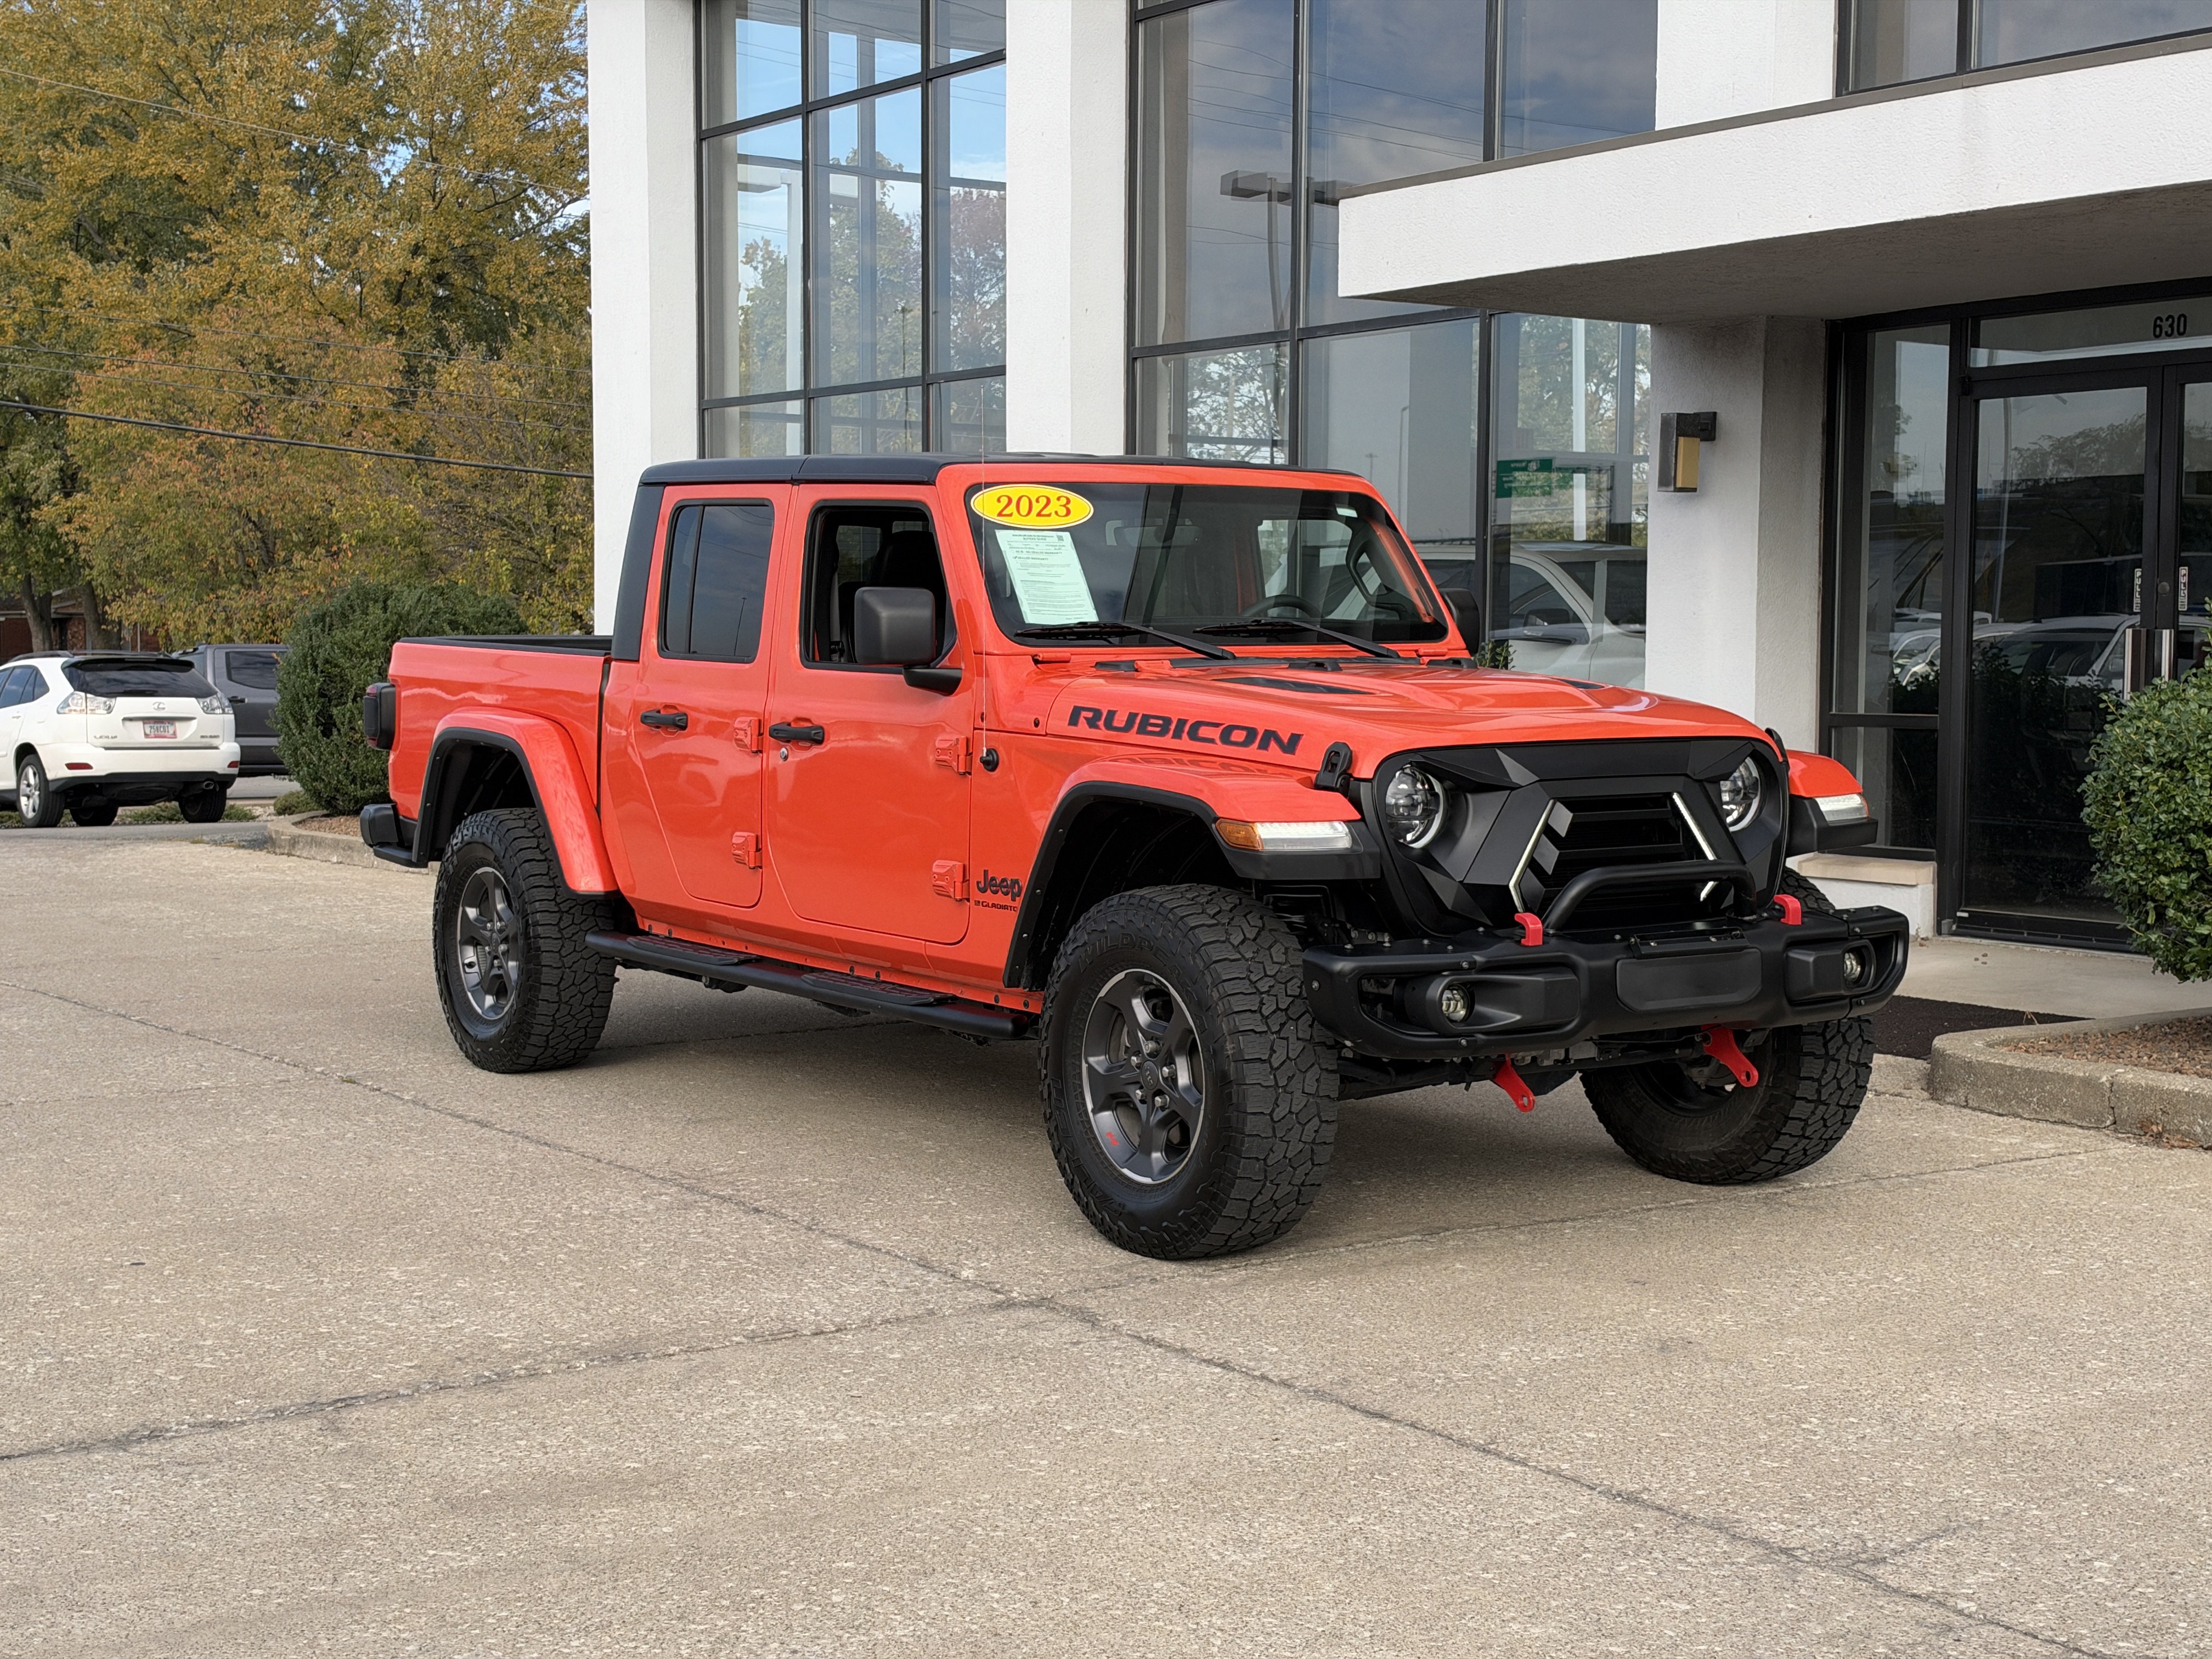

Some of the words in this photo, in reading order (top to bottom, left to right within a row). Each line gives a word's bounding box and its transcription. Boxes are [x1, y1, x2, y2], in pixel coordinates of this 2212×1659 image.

[2153, 313, 2187, 338] 630
[996, 494, 1071, 517] 2023
[1068, 706, 1304, 755] RUBICON
[976, 869, 1022, 902] Jeep
